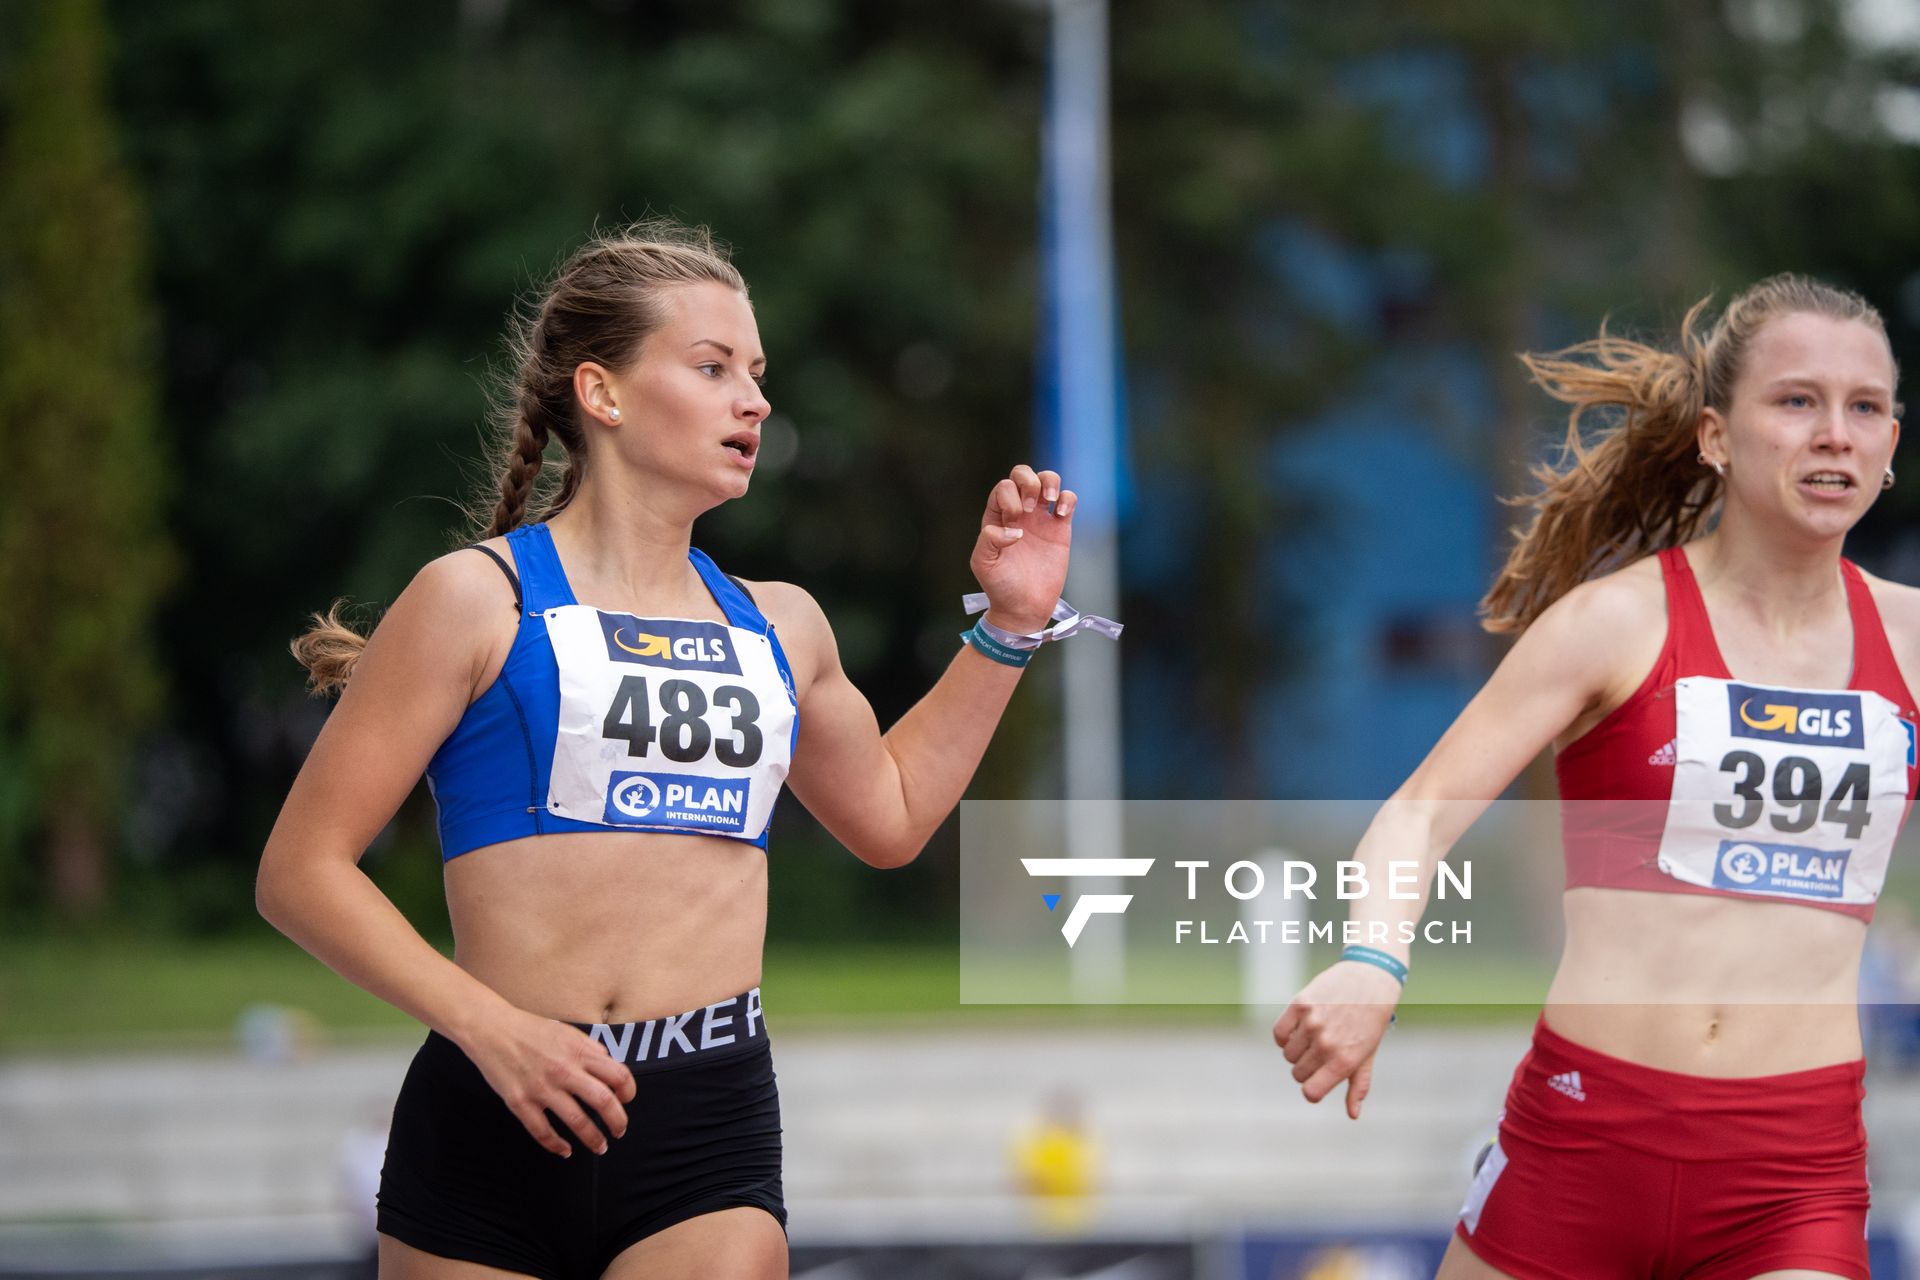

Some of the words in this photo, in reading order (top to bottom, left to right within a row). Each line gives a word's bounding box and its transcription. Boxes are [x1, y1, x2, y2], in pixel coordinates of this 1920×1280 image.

[673, 636, 726, 662] GLS
[602, 674, 763, 768] 483
[1797, 707, 1852, 738] GLS
[666, 783, 743, 813] PLAN
[1713, 750, 1872, 840] 394
[666, 811, 740, 826] INTERNATIONAL
[1771, 851, 1844, 881] PLAN
[1770, 879, 1840, 892] INTERNATIONAL
[589, 997, 738, 1063] NIKE
